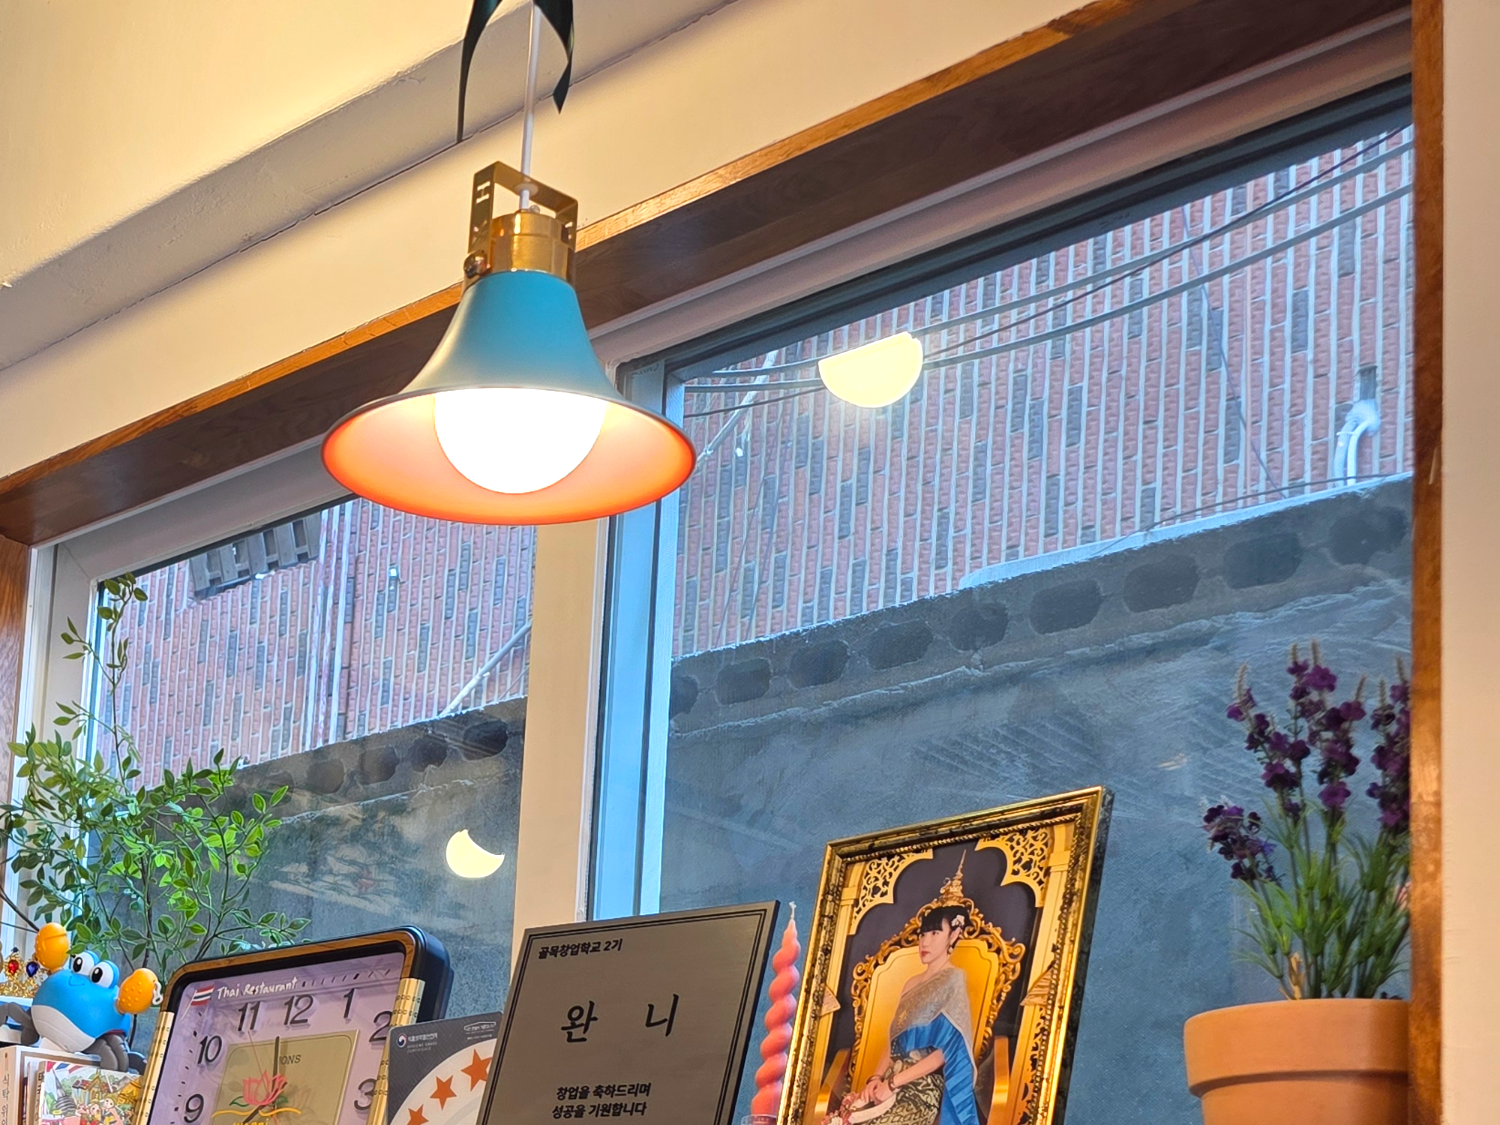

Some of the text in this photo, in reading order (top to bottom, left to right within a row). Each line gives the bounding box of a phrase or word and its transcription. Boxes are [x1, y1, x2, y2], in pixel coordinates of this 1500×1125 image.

[538, 938, 623, 960] 골목창업학교 2기
[217, 976, 298, 1000] Thai Restaurant
[237, 1001, 261, 1031] 11
[284, 994, 314, 1025] 12
[197, 1034, 223, 1065] 10
[2, 1073, 10, 1101] 식탁
[556, 1082, 652, 1101] 창업을 축하드리며
[185, 1093, 205, 1124] 9
[552, 1101, 647, 1119] 성공을 기원합니다
